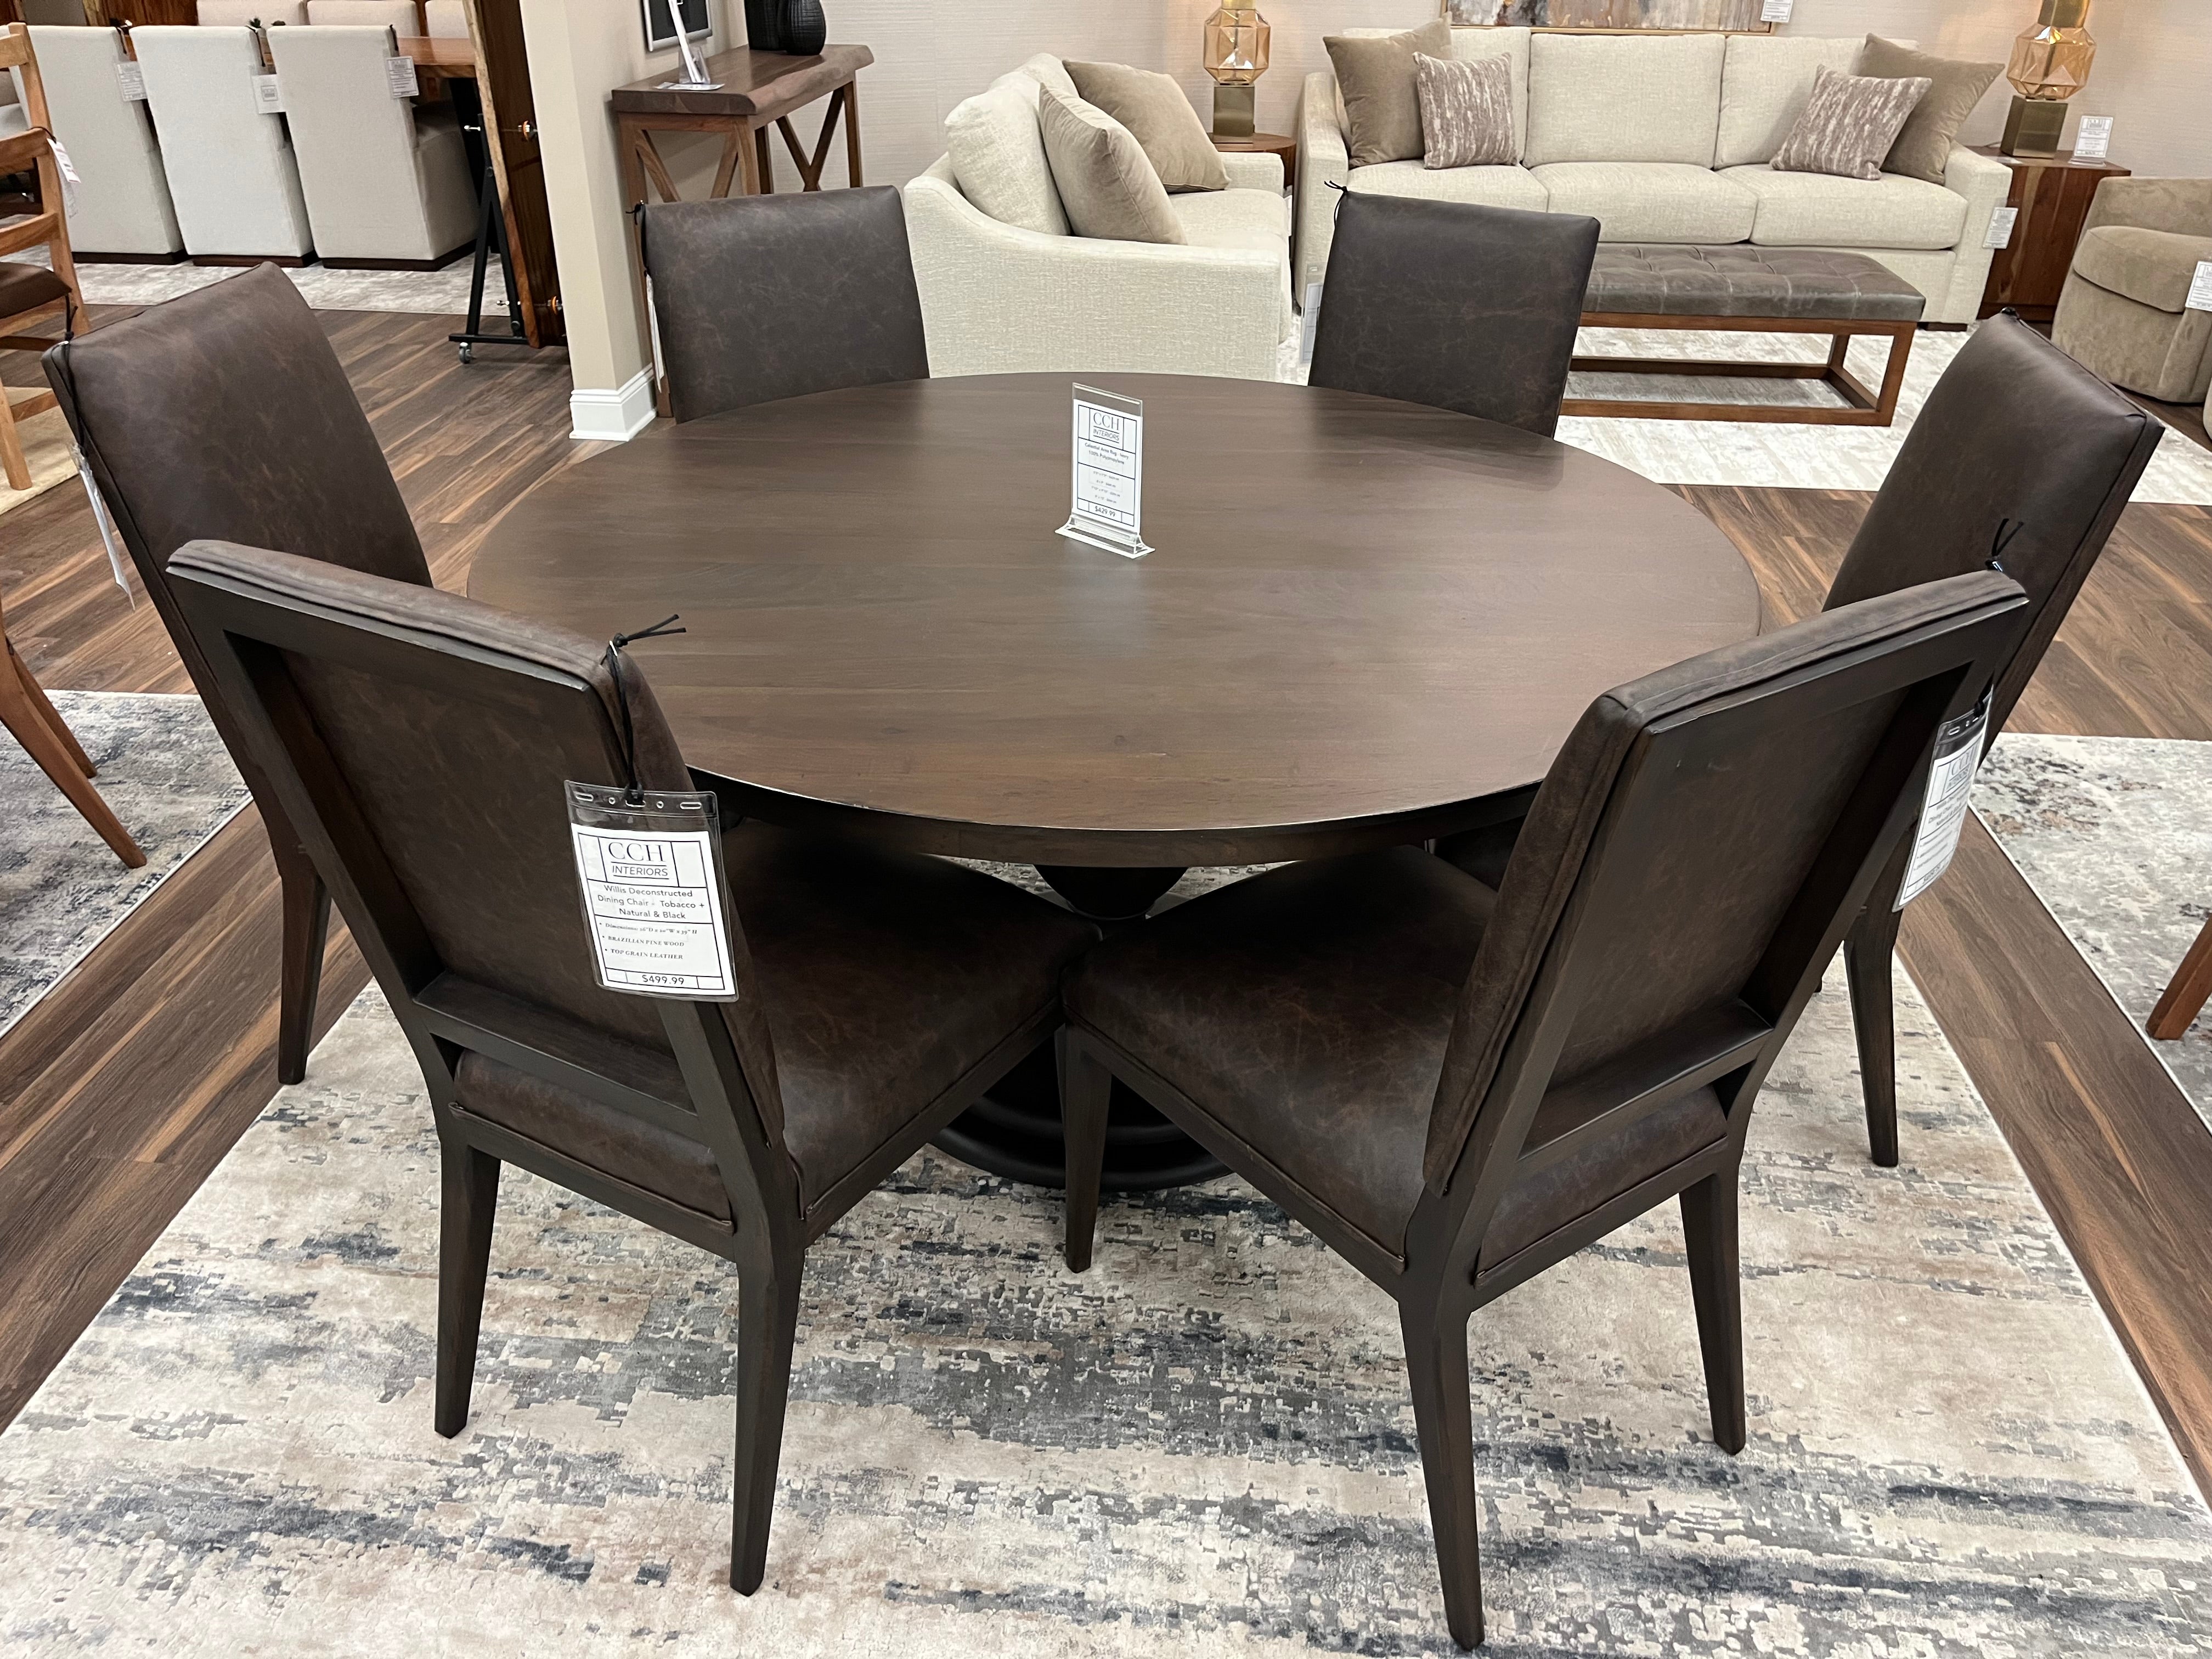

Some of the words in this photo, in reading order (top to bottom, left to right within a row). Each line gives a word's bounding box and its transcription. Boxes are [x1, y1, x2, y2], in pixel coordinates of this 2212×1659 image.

[1093, 412, 1120, 431] CCH
[1093, 428, 1120, 441] INTERIORS
[1094, 505, 1116, 517] $429.99
[608, 842, 666, 862] CCH
[612, 865, 668, 876] INTERIORS
[604, 884, 627, 894] Willis
[629, 888, 693, 897] Deconstructed
[597, 894, 624, 905] Dining
[627, 898, 650, 906] Chair
[660, 900, 696, 909] Tobacco
[619, 908, 651, 917] Natural
[642, 974, 685, 985] $499.99
